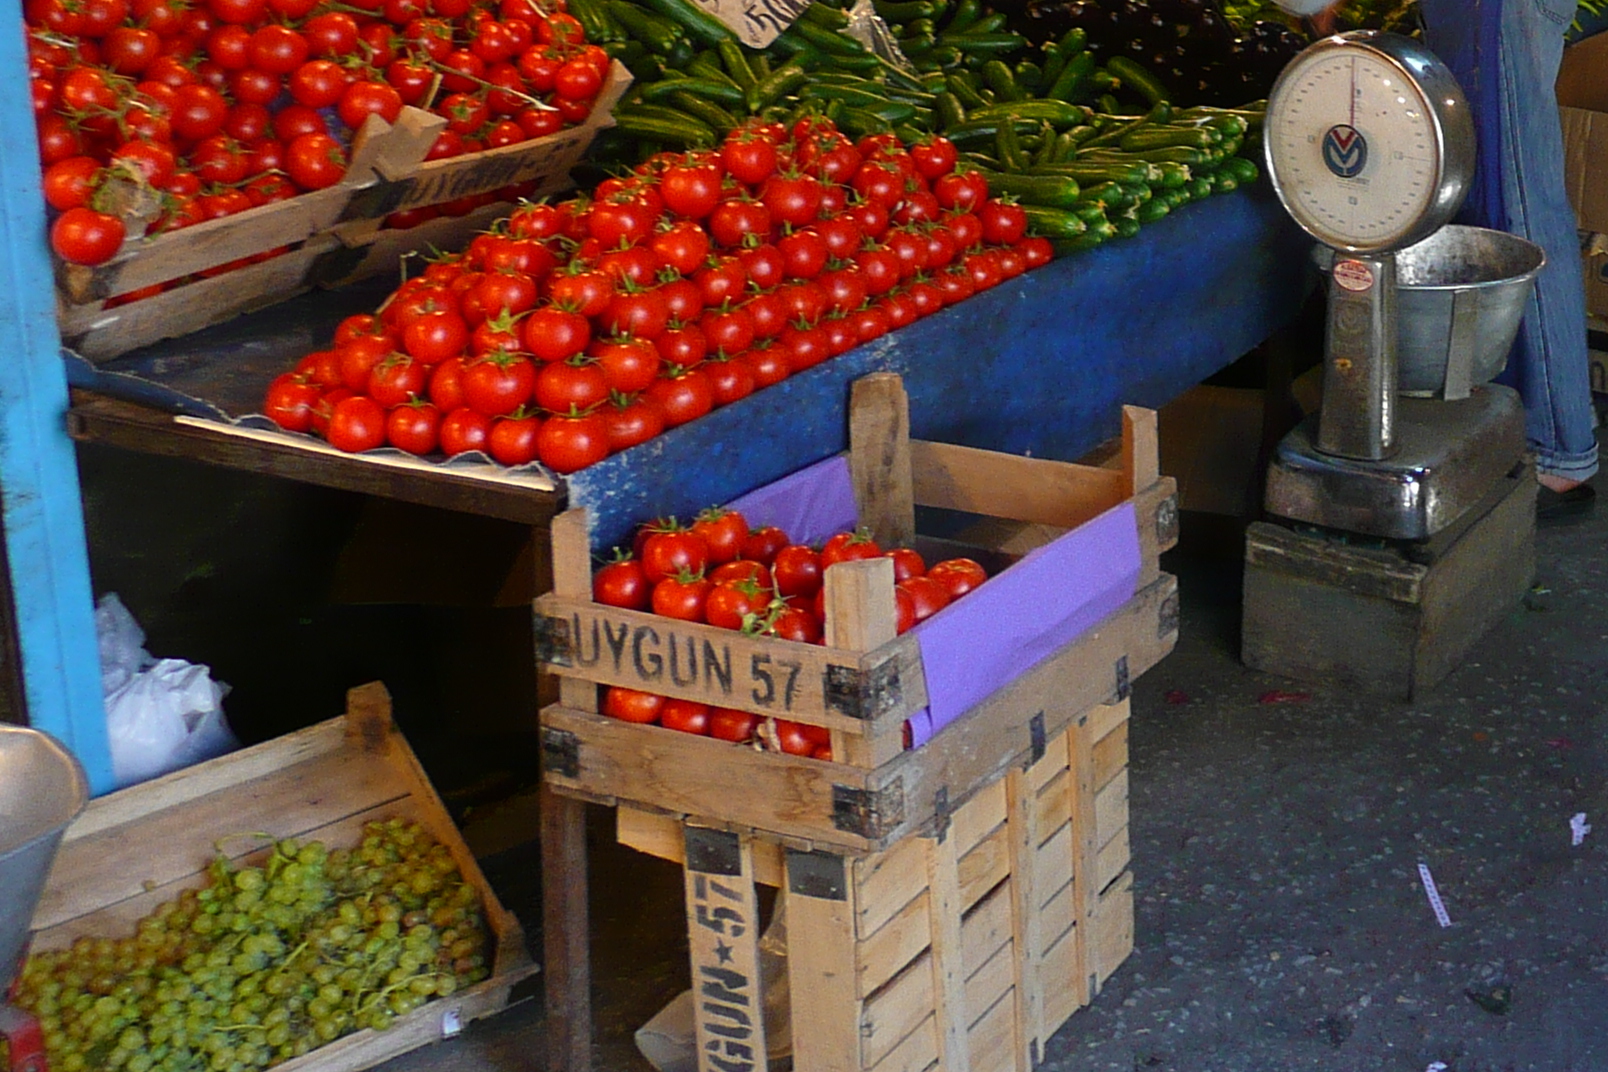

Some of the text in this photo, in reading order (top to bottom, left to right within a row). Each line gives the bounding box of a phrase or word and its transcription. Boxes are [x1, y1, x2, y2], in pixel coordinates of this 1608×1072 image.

[572, 612, 802, 711] UYGUN 57
[693, 874, 747, 938] 57
